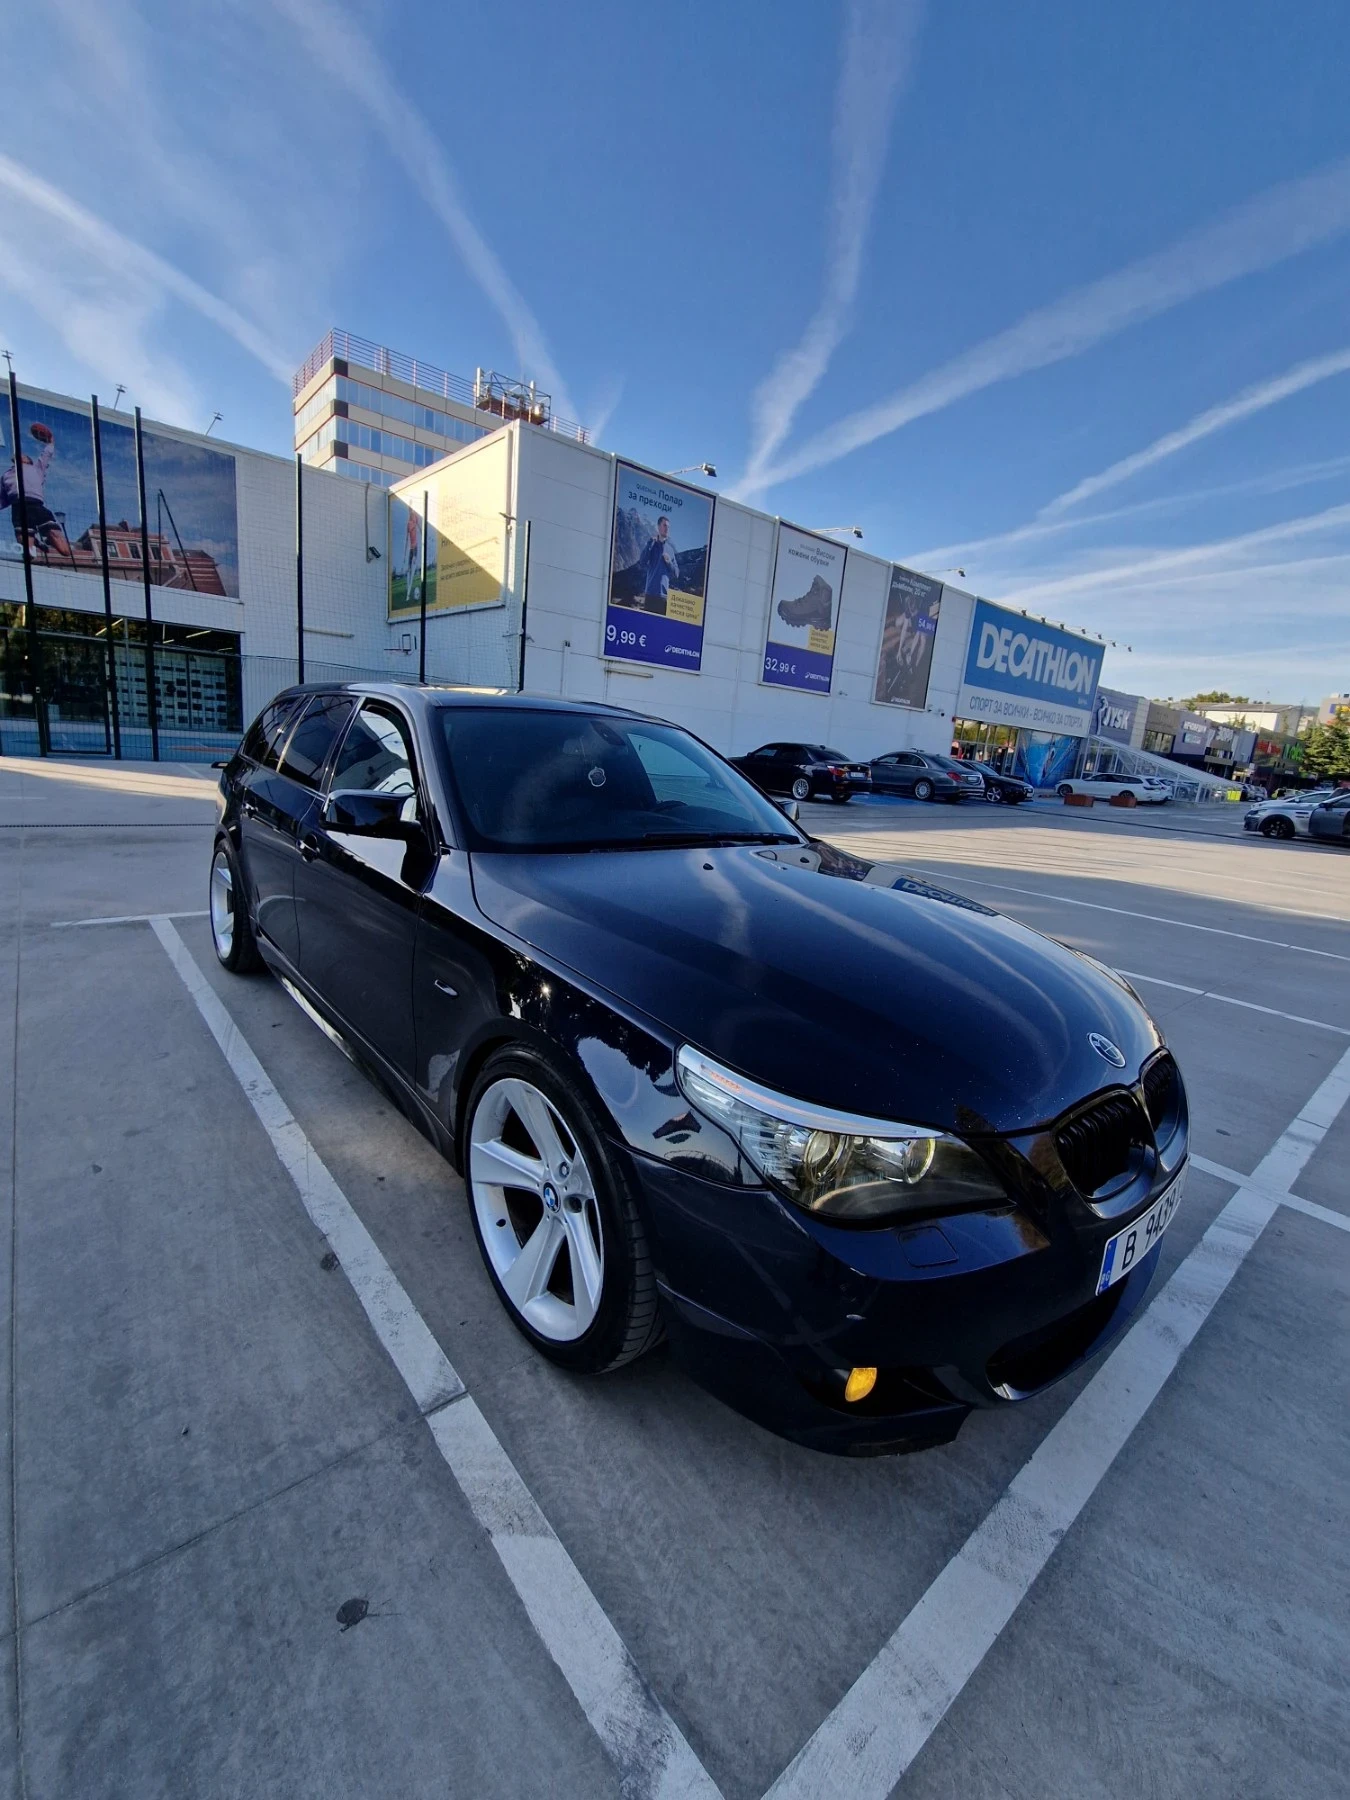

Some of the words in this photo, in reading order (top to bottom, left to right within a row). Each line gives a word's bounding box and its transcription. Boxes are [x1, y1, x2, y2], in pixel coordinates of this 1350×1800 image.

[628, 491, 638, 501] за
[638, 494, 673, 512] преходи
[658, 489, 683, 507] Полар
[606, 624, 636, 645] 9,99
[639, 634, 648, 647] €
[765, 657, 789, 674] 32,99
[791, 665, 797, 675] €
[976, 621, 1097, 695] DECATHLON
[969, 695, 994, 713] СПОРТ
[994, 701, 1003, 714] ЗА
[1003, 703, 1030, 719] ВСИЧКИ
[1033, 707, 1055, 725] ВСИЧКО
[1055, 713, 1063, 725] ЗА
[1063, 714, 1083, 729] СПОРТА
[1103, 706, 1132, 730] JYSK
[1121, 1230, 1138, 1271] B
